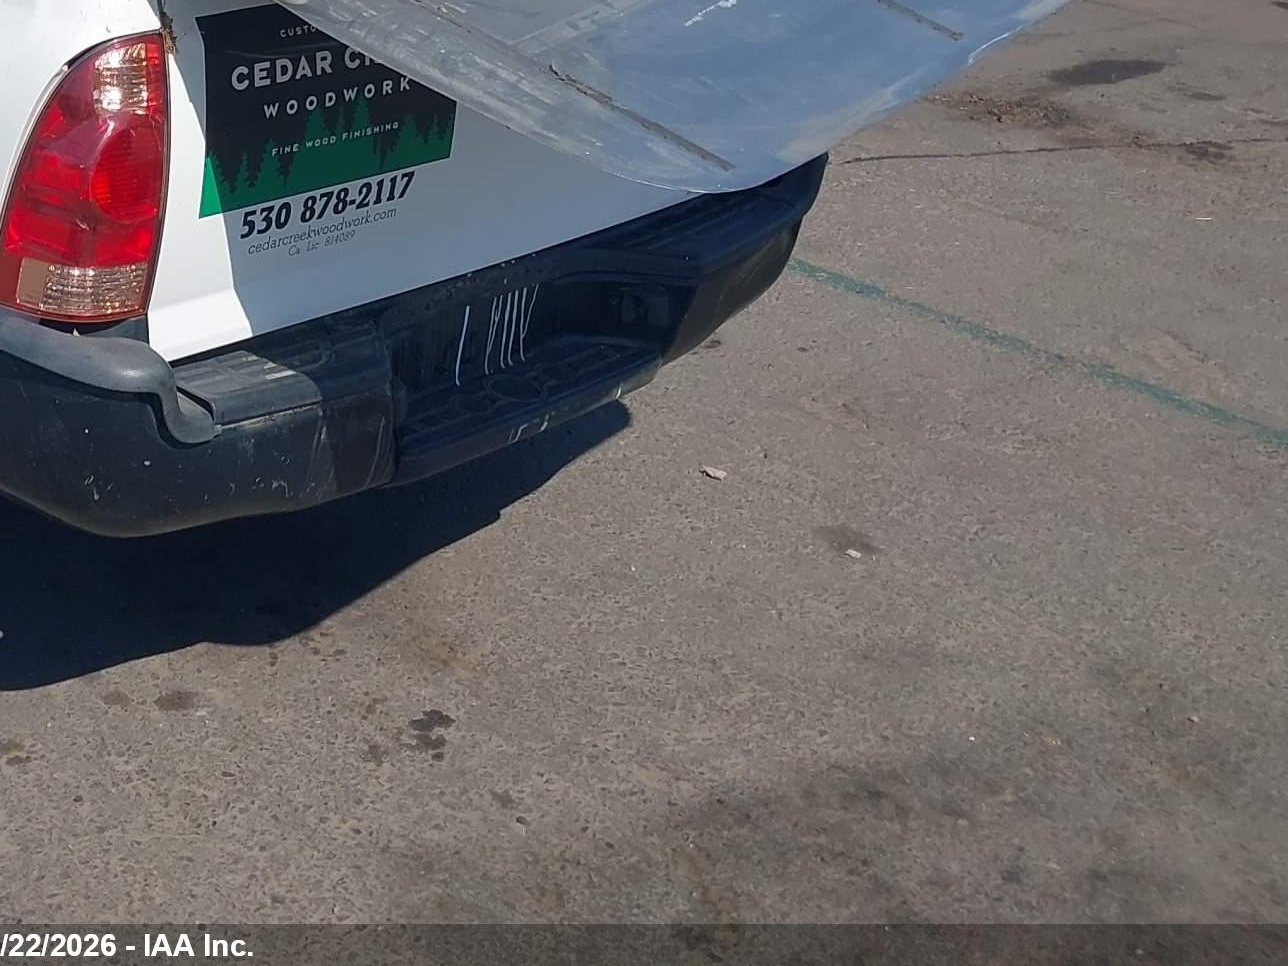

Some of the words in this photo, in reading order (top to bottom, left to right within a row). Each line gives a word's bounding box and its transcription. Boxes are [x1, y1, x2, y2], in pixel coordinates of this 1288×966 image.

[280, 24, 317, 38] CUSTO
[231, 50, 333, 91] CEDAR
[263, 76, 411, 119] WOODWORK
[272, 143, 300, 157] FINE
[305, 136, 337, 149] WOOD
[342, 121, 399, 141] FINISHING
[240, 201, 292, 239] 530
[300, 170, 415, 223] 878-2117
[248, 208, 397, 255] cedarcreekwoodwork.com
